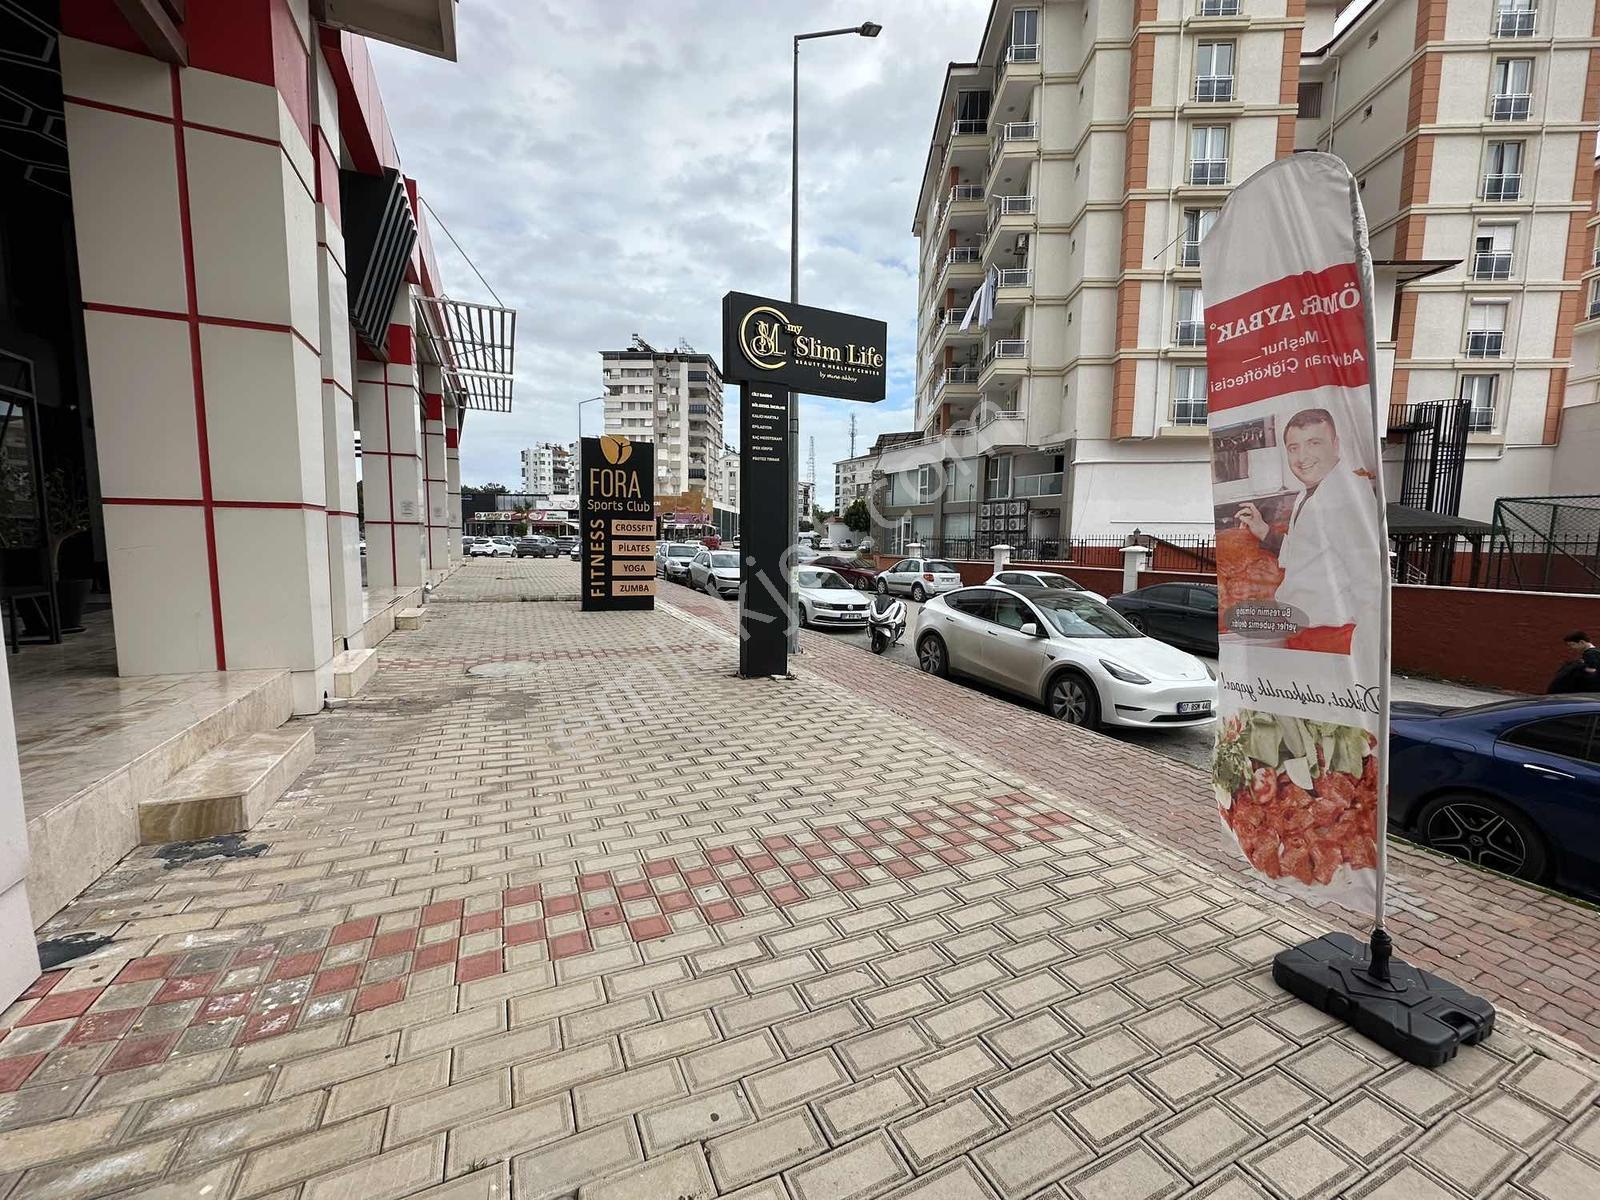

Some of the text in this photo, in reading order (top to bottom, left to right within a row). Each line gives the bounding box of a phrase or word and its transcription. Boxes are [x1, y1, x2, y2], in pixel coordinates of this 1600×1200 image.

[787, 323, 803, 335] my
[796, 336, 884, 368] Slim Life
[589, 468, 642, 498] FORA
[587, 500, 624, 512] Sports
[627, 500, 651, 512] Club
[615, 523, 654, 532] CROSSFIT
[618, 542, 651, 552] PİLATES
[590, 519, 605, 597] FITNESS
[623, 563, 646, 572] YOGA
[620, 584, 650, 593] ZUMBA
